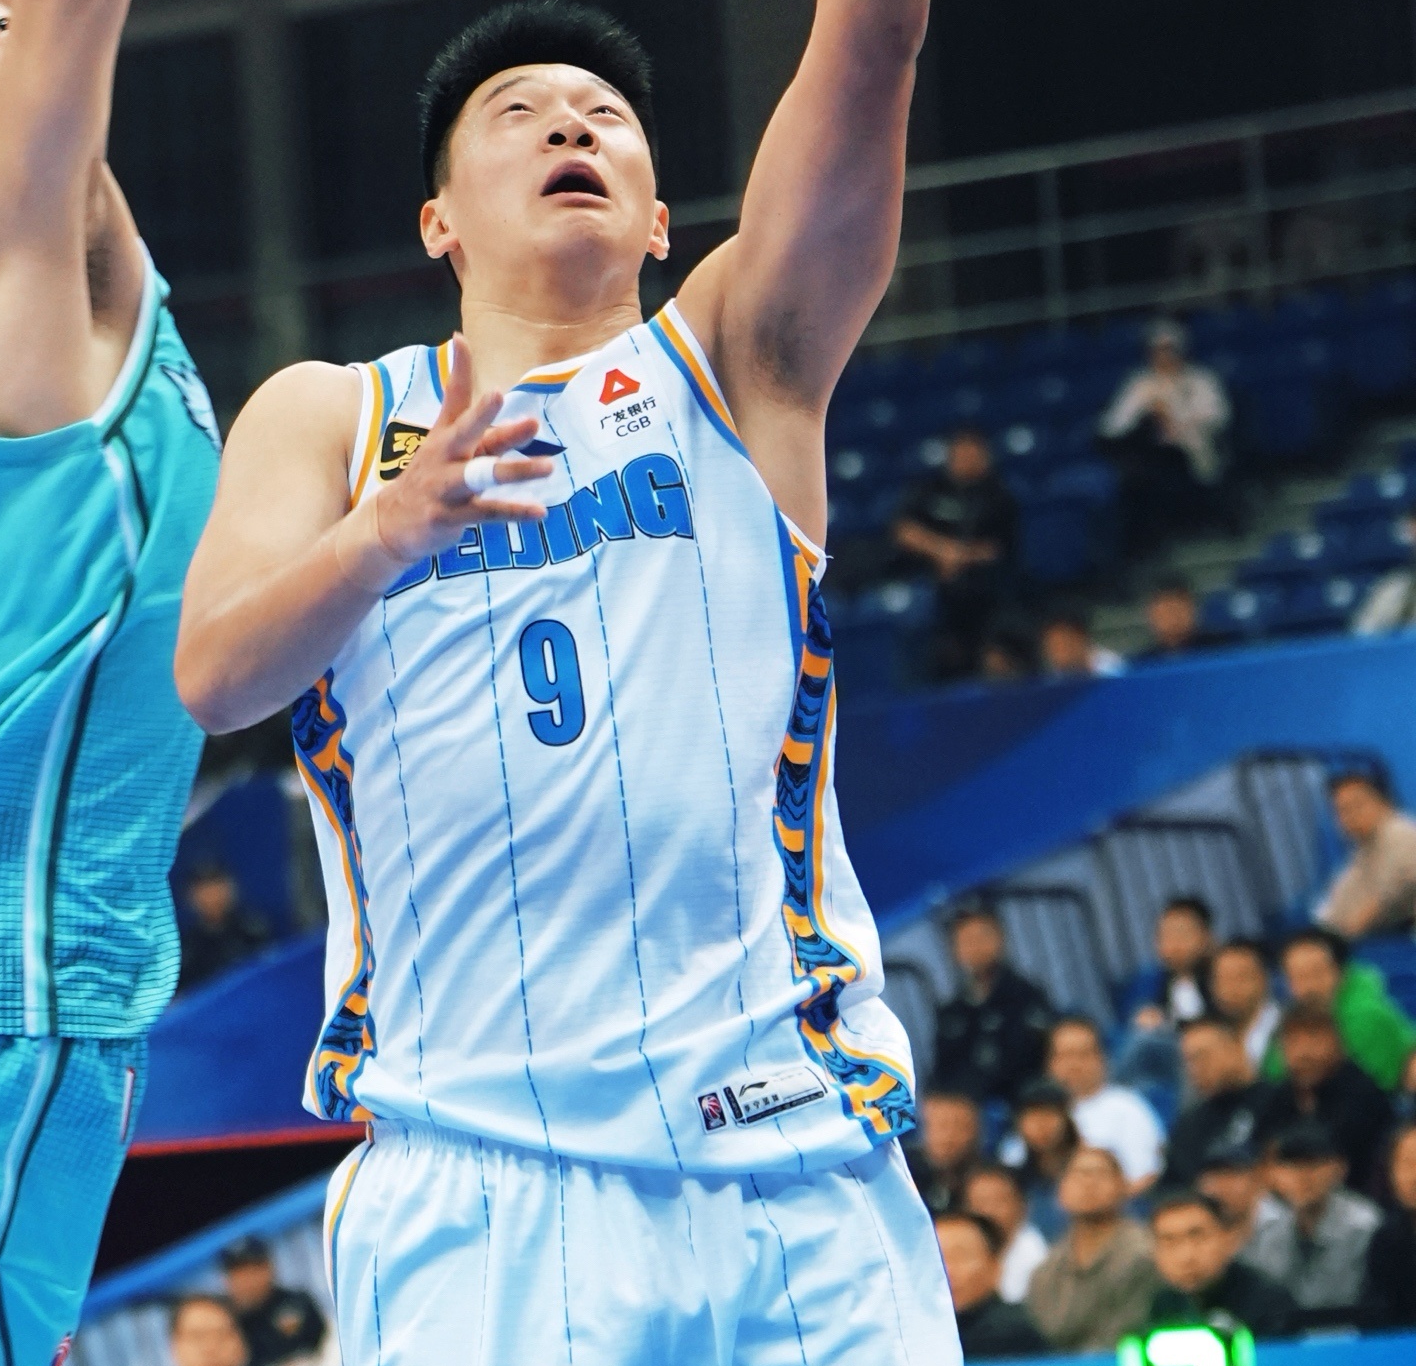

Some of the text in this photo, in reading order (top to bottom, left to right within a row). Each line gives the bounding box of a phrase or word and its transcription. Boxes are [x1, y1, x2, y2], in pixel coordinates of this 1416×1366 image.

[600, 396, 657, 430] 广发银行
[616, 415, 651, 438] CGB
[519, 619, 586, 747] 9
